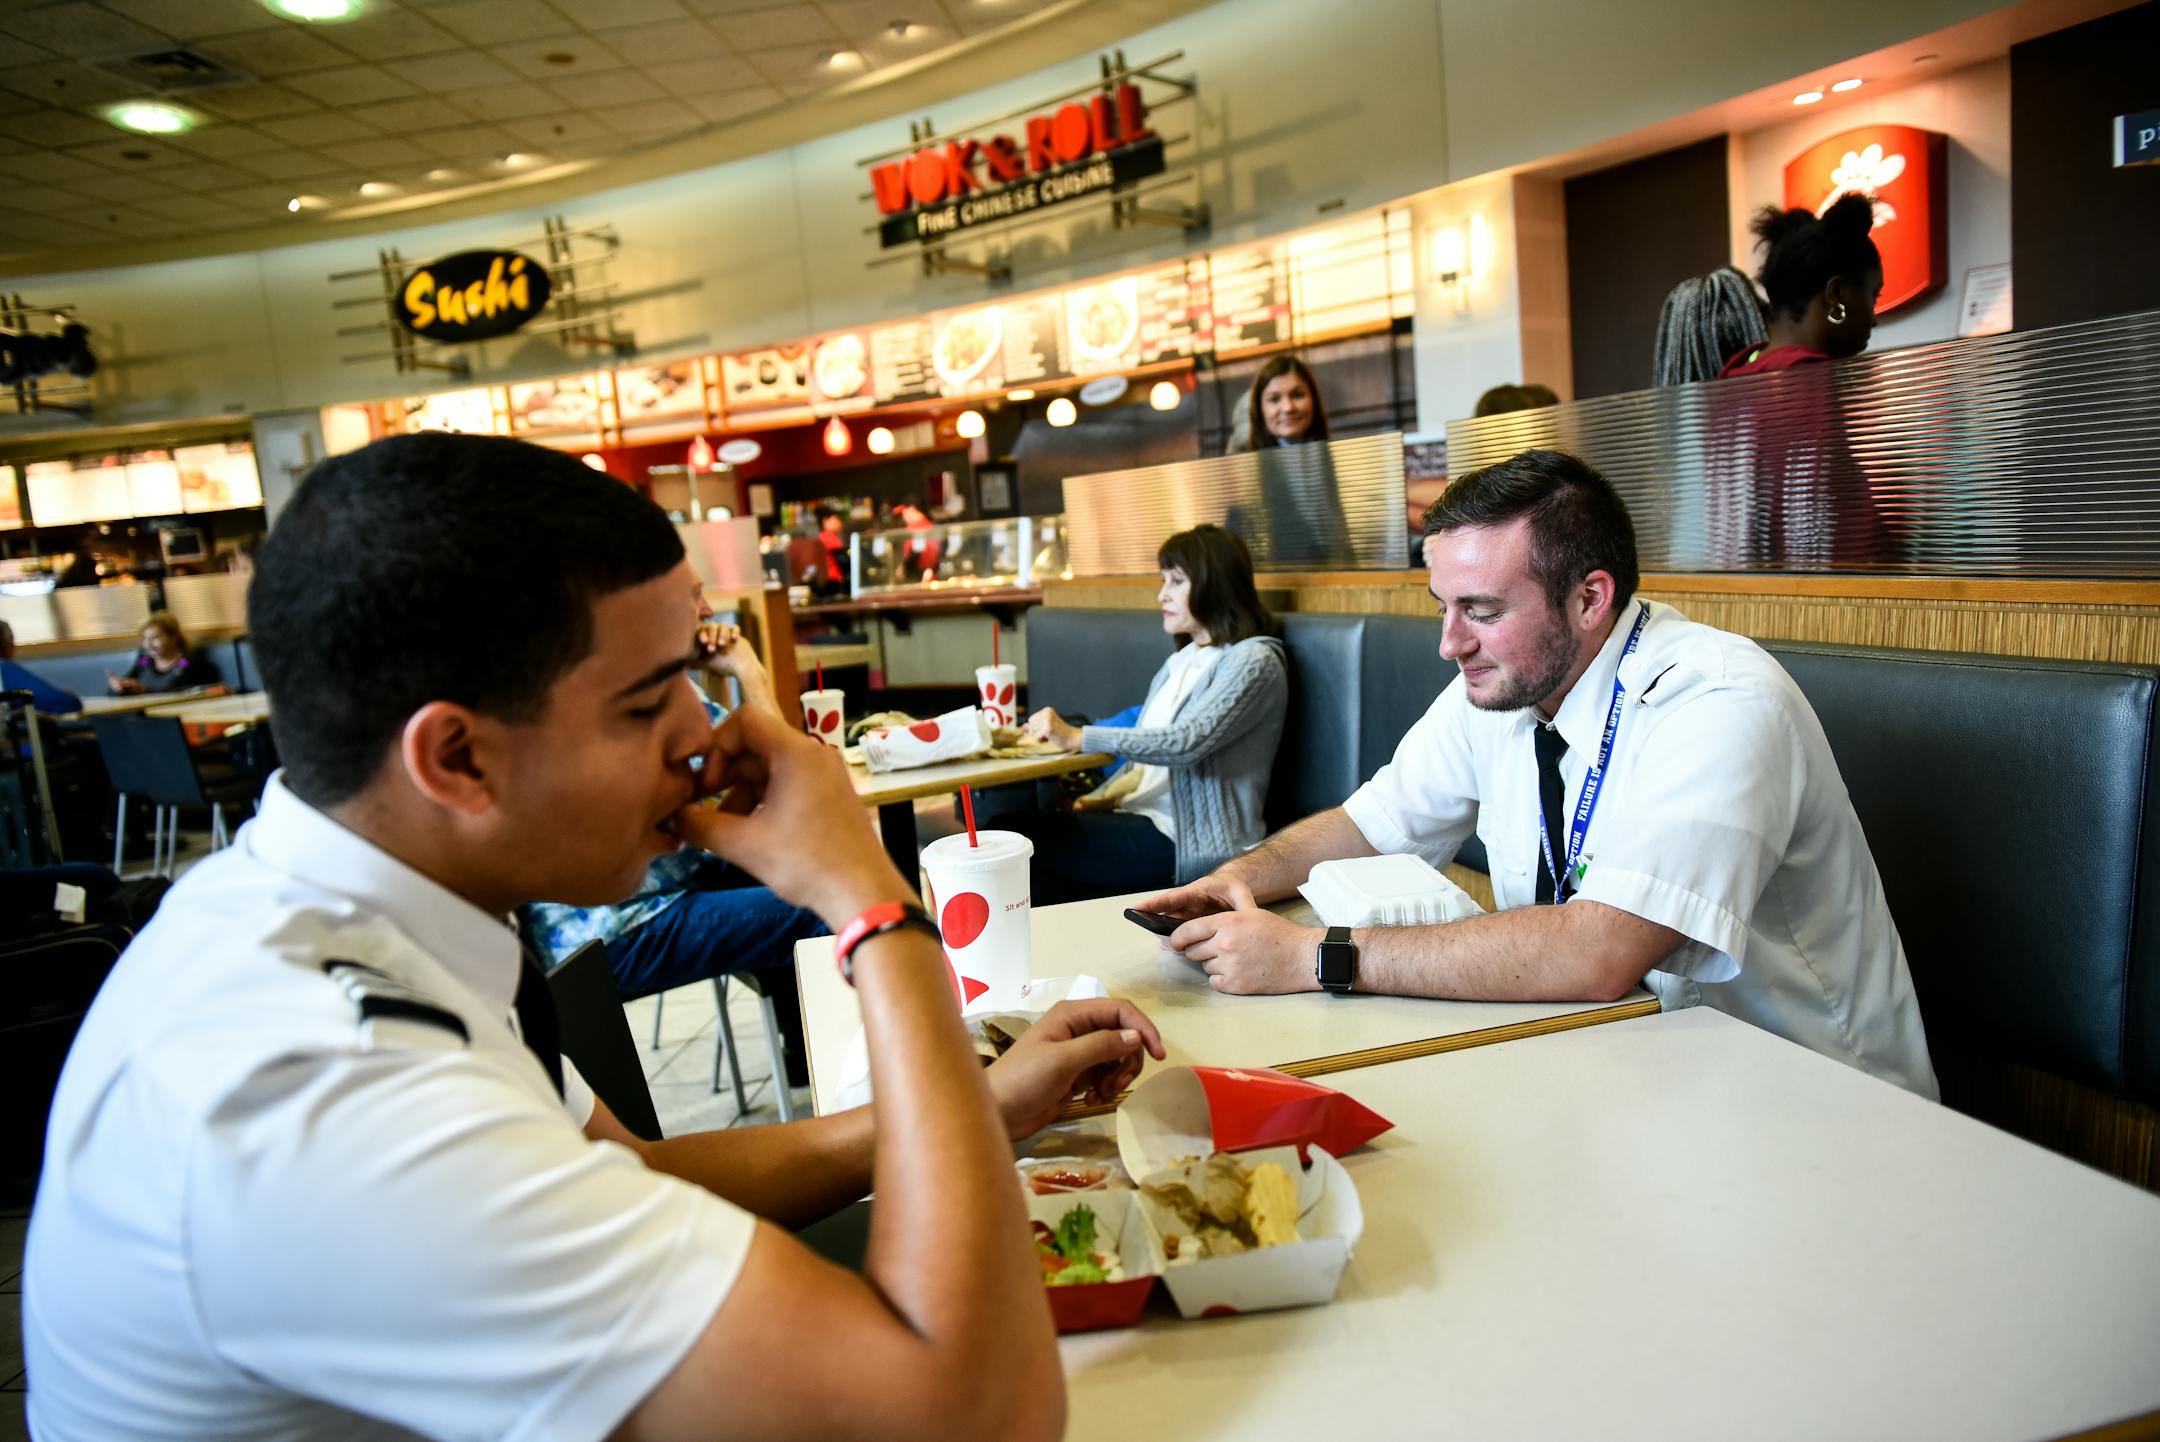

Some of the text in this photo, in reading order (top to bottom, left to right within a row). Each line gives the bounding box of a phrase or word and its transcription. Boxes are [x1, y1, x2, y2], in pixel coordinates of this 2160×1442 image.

[1026, 82, 1156, 173] ROLL
[917, 161, 1115, 237] FINE CHINESE CUISINE
[404, 255, 530, 330] Sushi
[1577, 690, 1626, 822] FAILURE IS NOT AN OPTION
[1568, 830, 1583, 866] OPTION
